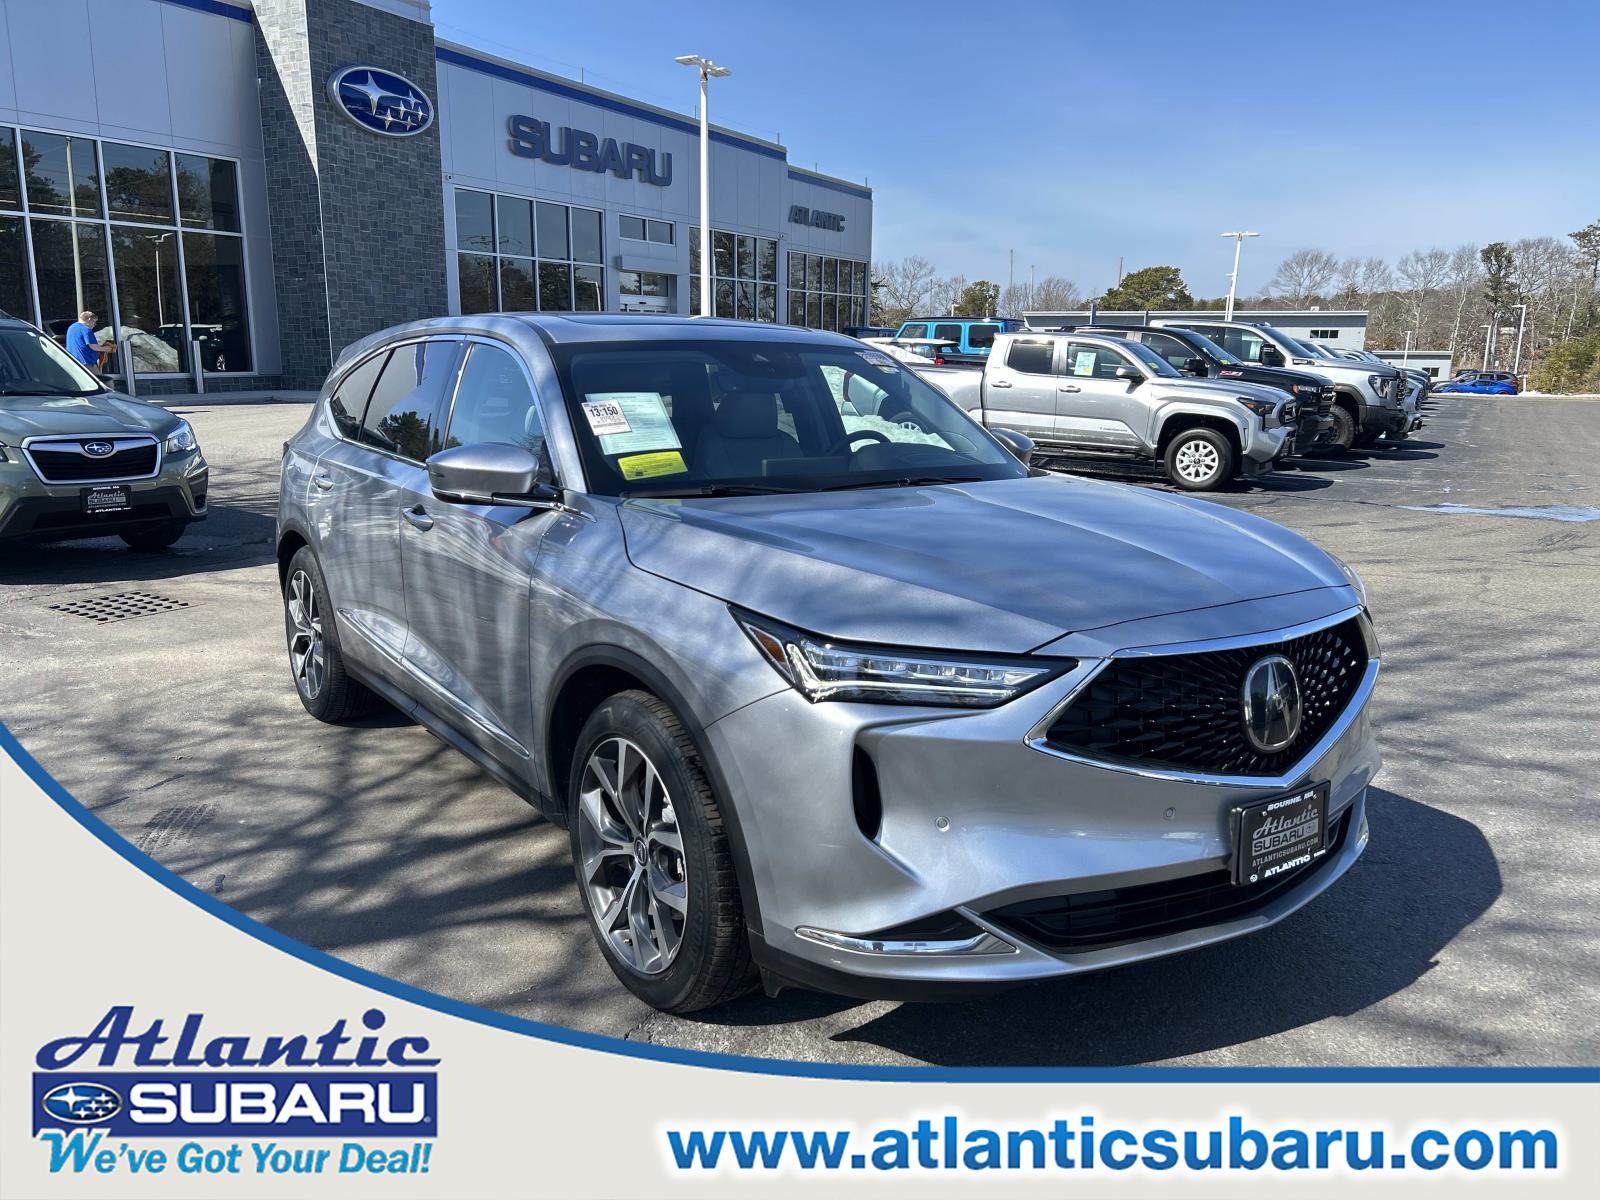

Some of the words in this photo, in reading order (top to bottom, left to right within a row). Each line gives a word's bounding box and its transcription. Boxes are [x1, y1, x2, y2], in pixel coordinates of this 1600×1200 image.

[508, 114, 673, 187] SUBARU
[788, 204, 846, 232] ATLANTIC
[1253, 804, 1319, 839] Atlantic
[1252, 837, 1319, 867] ATLANTICSUBARU.COM
[1254, 828, 1304, 853] SUBARU
[1264, 854, 1311, 878] ATLANTIC
